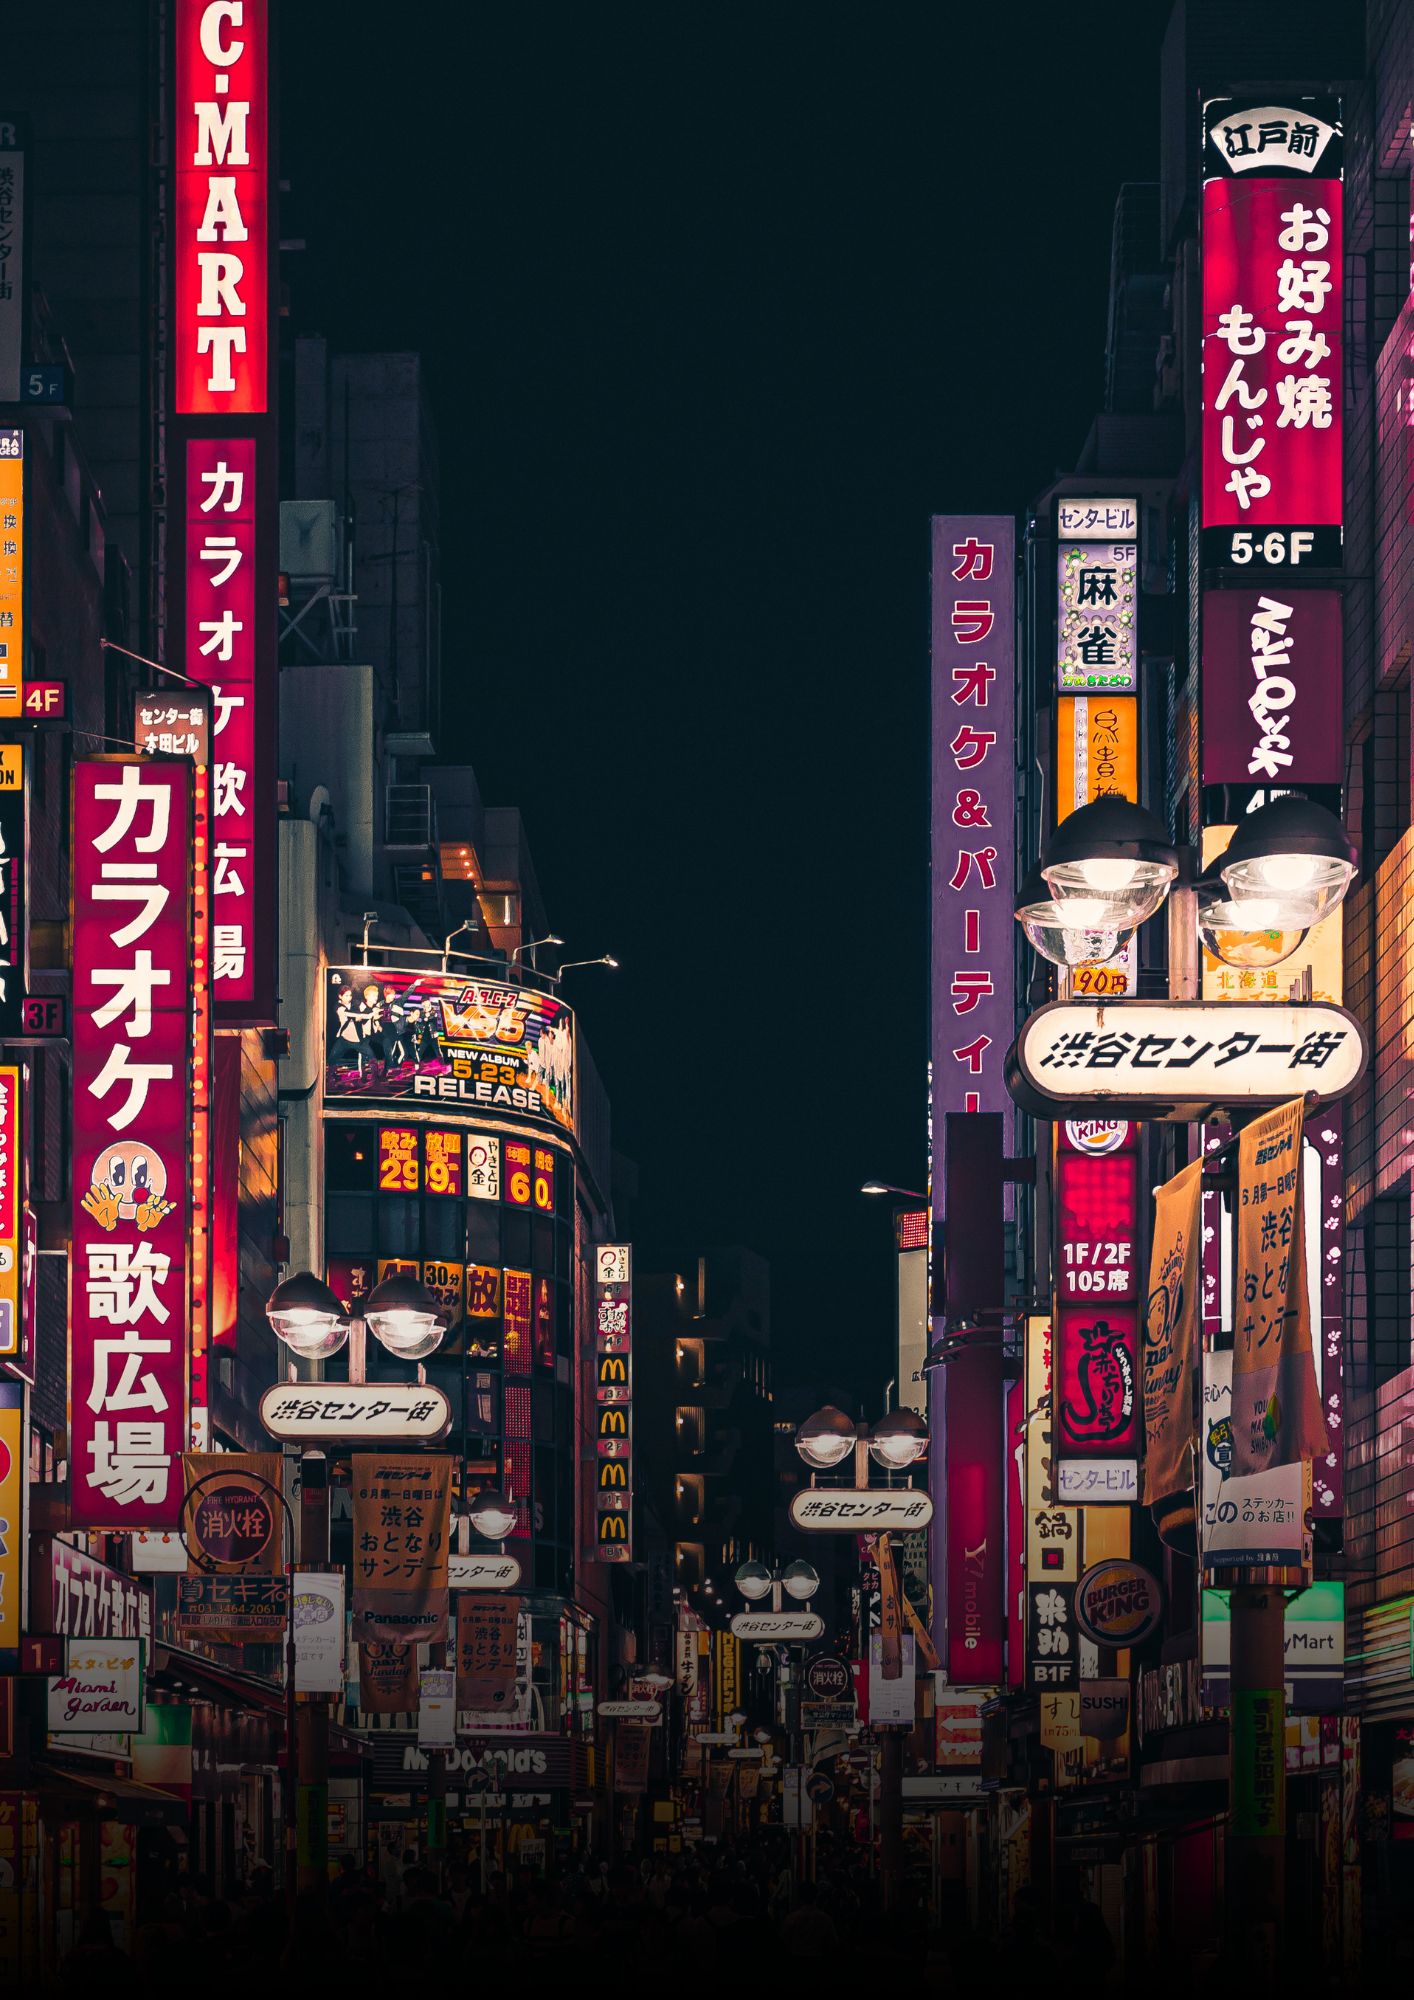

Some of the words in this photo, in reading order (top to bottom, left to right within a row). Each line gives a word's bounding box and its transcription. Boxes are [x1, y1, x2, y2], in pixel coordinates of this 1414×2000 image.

[1224, 122, 1320, 158] 江戸前
[1276, 203, 1333, 429] お好み焼
[1214, 305, 1272, 510] もんじゃ
[1060, 507, 1135, 529] センタービル
[1113, 547, 1135, 561] 5F
[1077, 565, 1118, 666] 麻雀
[26, 689, 60, 713] 4F
[140, 708, 204, 725] センター街
[88, 765, 173, 1132] カラオケ
[1217, 971, 1279, 989] 北海道
[28, 1002, 58, 1029] 3F
[447, 1049, 479, 1061] NEW
[480, 1053, 520, 1068] ALBUM
[1040, 1031, 1348, 1068] 渋谷センター街
[453, 1063, 517, 1086] 5.23
[414, 1076, 542, 1111] RELEASE
[1077, 1120, 1118, 1140] KING
[488, 1141, 498, 1196] やきとり
[1063, 1243, 1131, 1265] 1F/2F
[426, 1265, 459, 1287] 30分
[1066, 1269, 1130, 1292] 105席
[1243, 1306, 1299, 1353] サンデー
[85, 1241, 172, 1507] 歌広場
[270, 1400, 439, 1422] 渋谷センター街
[1060, 1469, 1136, 1490] センタービル
[800, 1502, 928, 1517] 渋谷センター街
[1242, 1498, 1294, 1509] ステッカー
[202, 1511, 265, 1539] 消火栓
[381, 1506, 424, 1528] 渋谷
[1035, 1511, 1073, 1540] 鍋
[361, 1532, 442, 1552] おとなり
[360, 1558, 443, 1578] サンデー
[1086, 1578, 1147, 1608] BURGER
[364, 1612, 438, 1624] Panasonic
[1089, 1592, 1150, 1627] KING
[736, 1620, 815, 1632] 渋谷センター街
[813, 1671, 844, 1686] 消火栓
[1034, 1665, 1072, 1682] B1F
[1082, 1697, 1129, 1709] SUSHI
